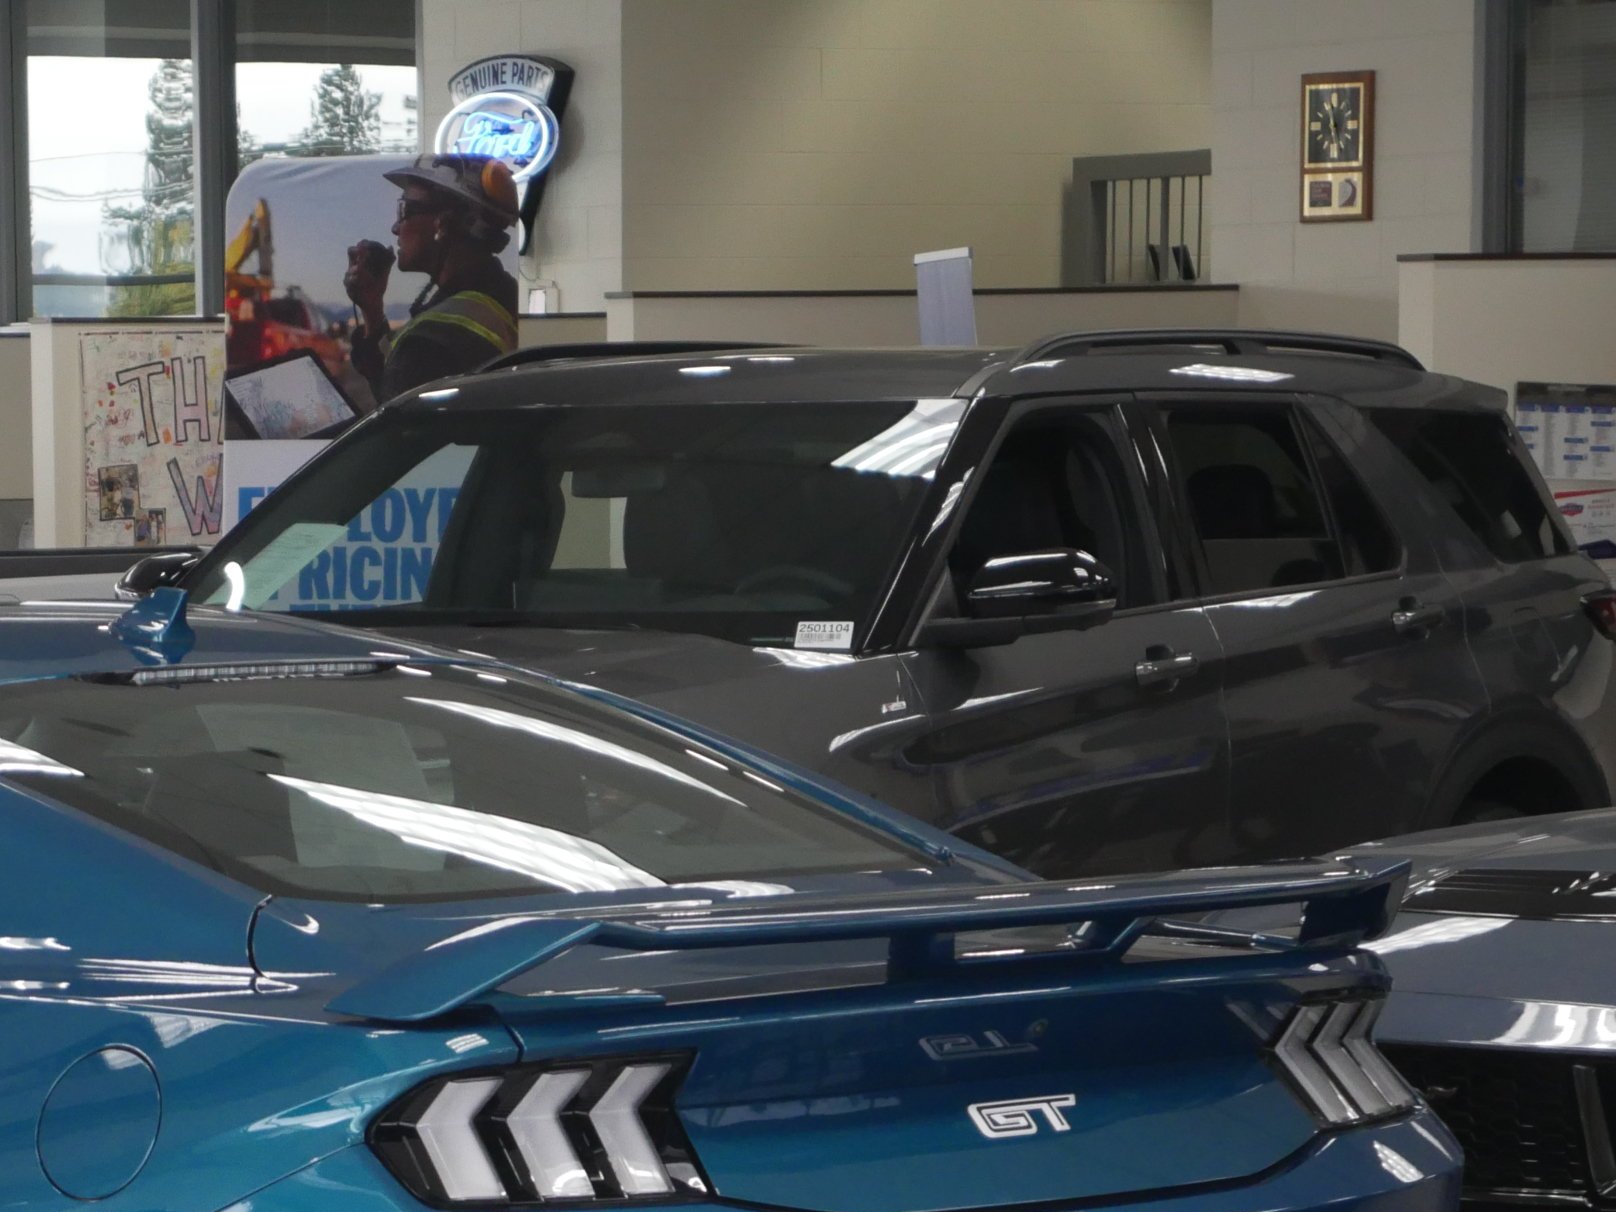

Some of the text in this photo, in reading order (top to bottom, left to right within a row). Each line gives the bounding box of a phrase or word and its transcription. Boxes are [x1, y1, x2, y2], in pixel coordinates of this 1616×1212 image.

[455, 62, 549, 97] GENUINE PARTS
[456, 111, 535, 158] Ford
[116, 356, 224, 447] TH
[274, 545, 434, 601] RICIN
[799, 623, 850, 633] 2501104
[967, 1093, 1076, 1138] GT
